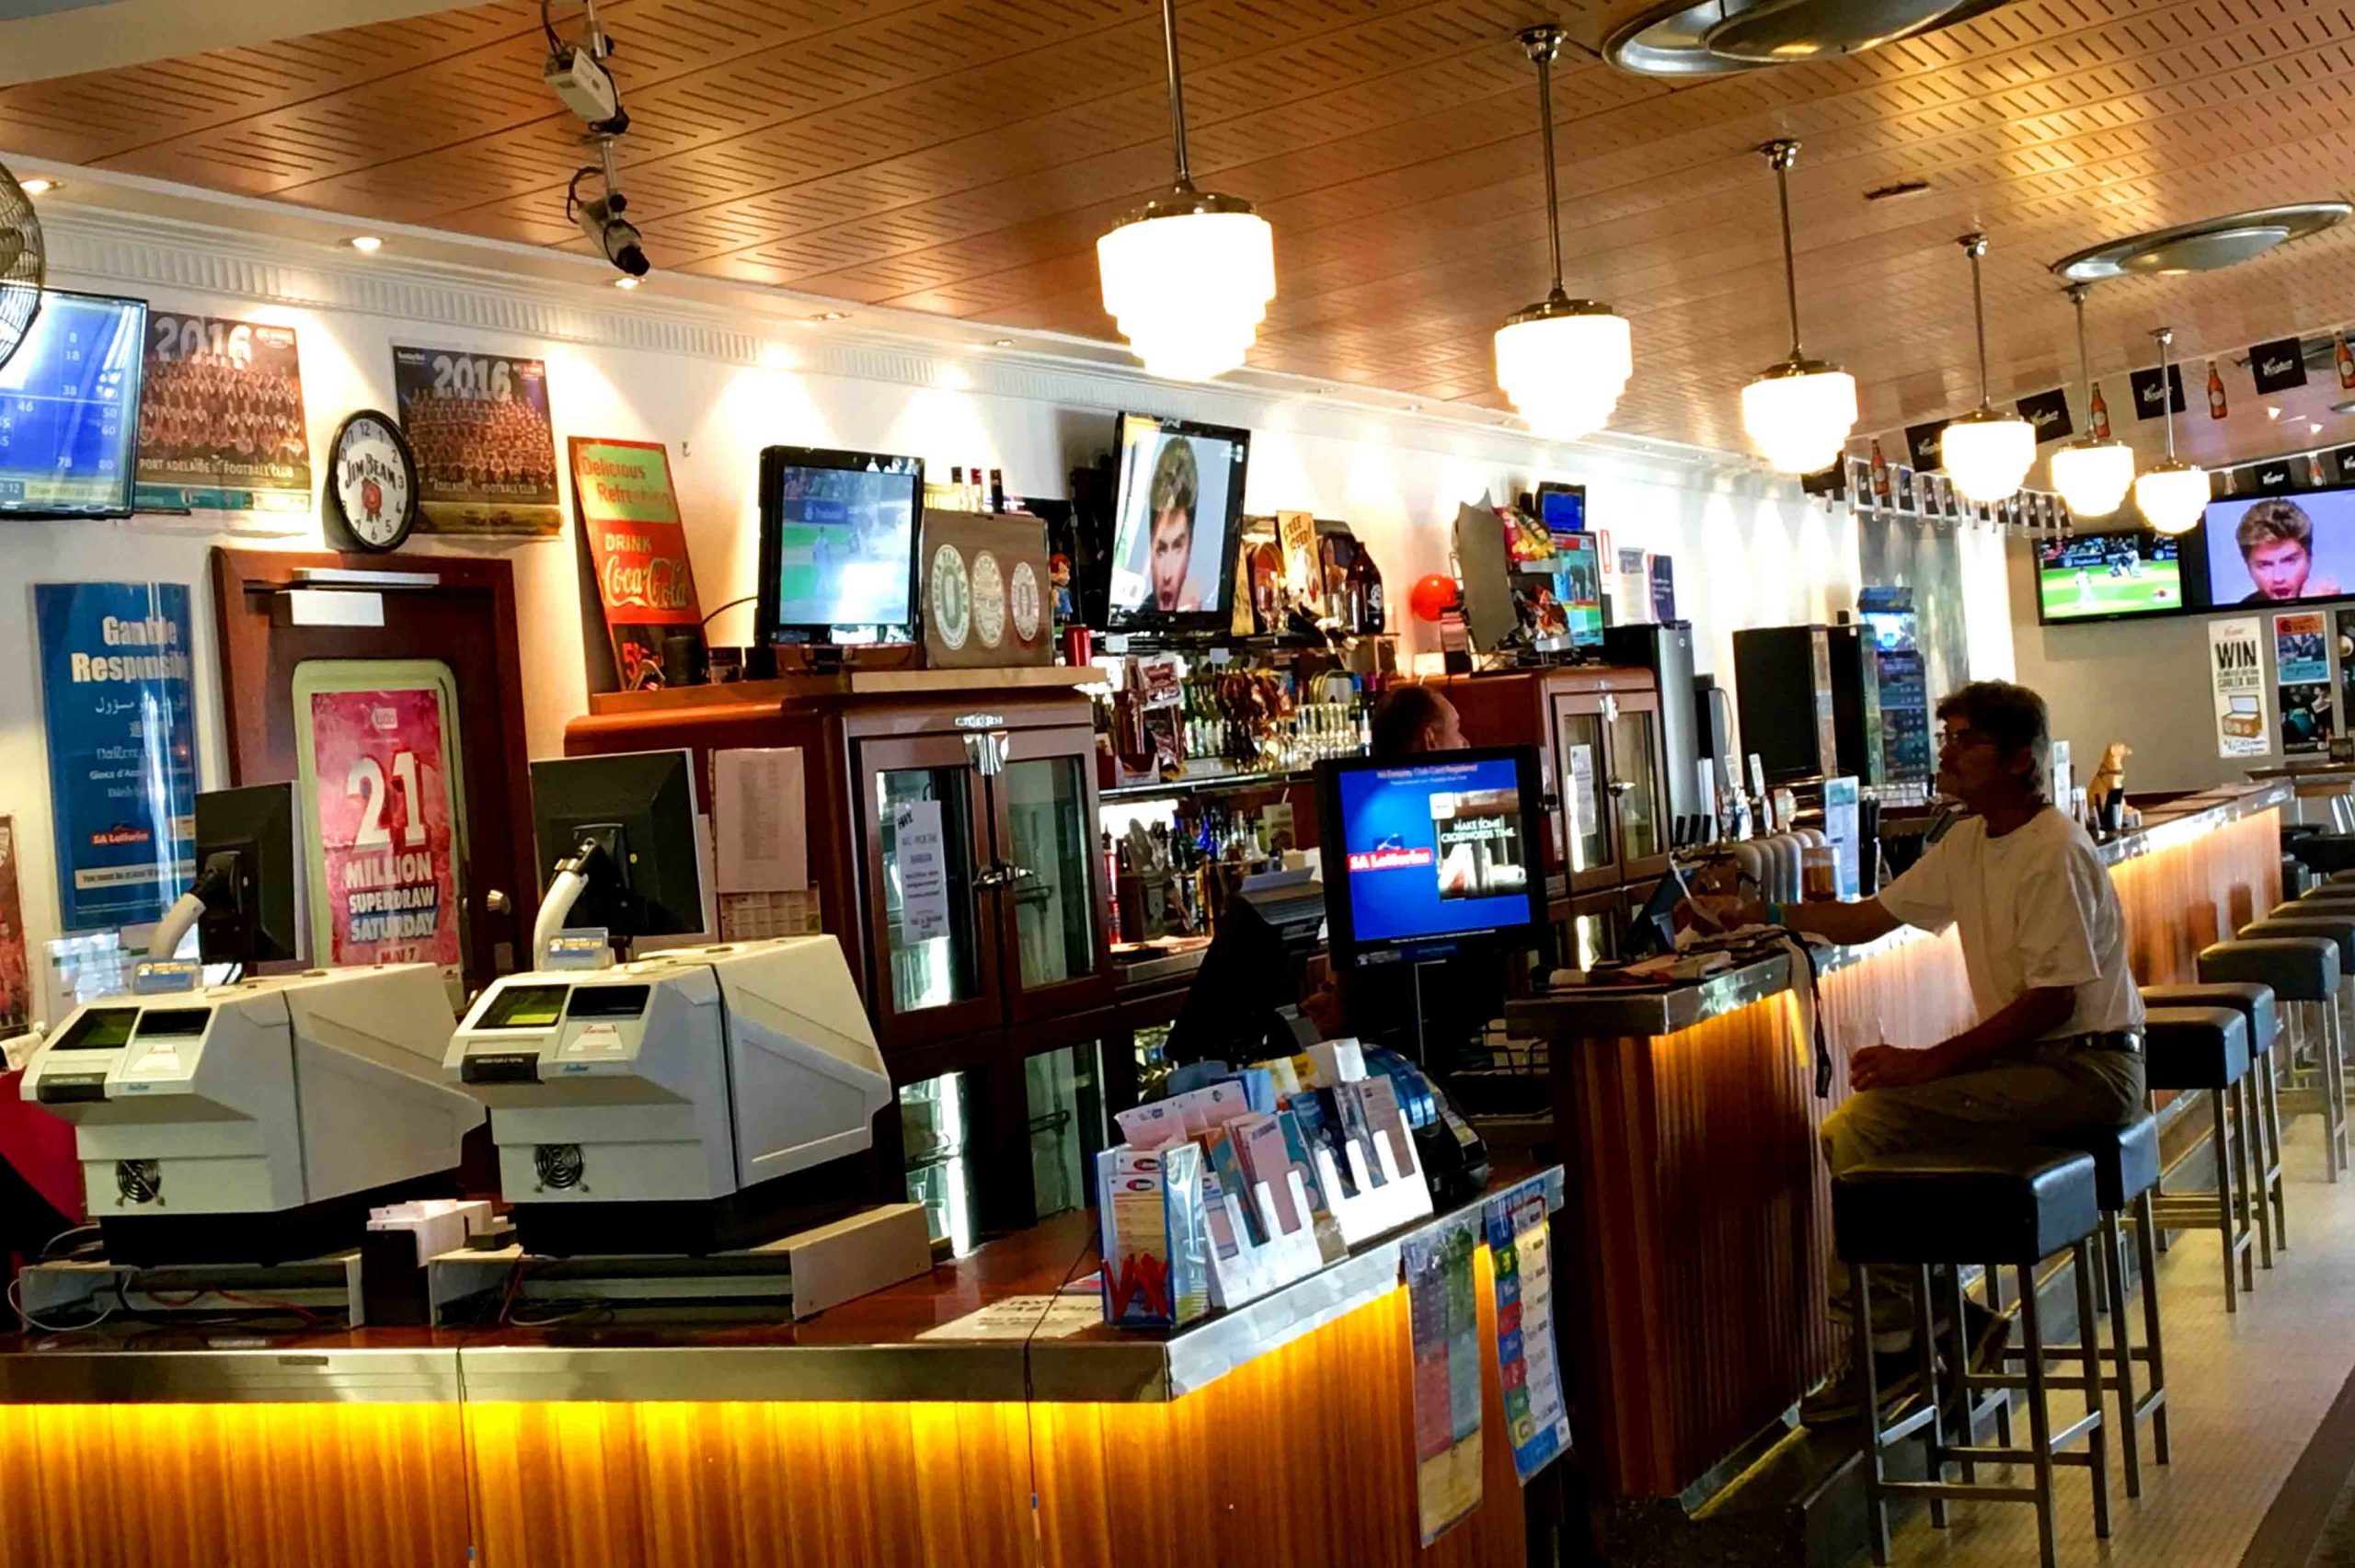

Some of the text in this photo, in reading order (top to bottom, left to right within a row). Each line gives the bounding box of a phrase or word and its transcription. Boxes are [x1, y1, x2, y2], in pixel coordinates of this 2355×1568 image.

[155, 316, 253, 370] 2016
[432, 355, 512, 402] 2016
[17, 400, 34, 413] 46
[101, 424, 116, 435] 60
[360, 422, 370, 437] 12
[140, 458, 295, 478] PORT ADELAIDE FOOTBALL CLUB
[344, 452, 397, 491] JIM BEAM
[581, 456, 646, 479] Delicious
[603, 532, 653, 553] DRINK
[603, 555, 688, 608] Coca-Cola
[102, 615, 178, 646] Gamble
[2215, 639, 2257, 670] WIN
[346, 751, 427, 850] 21
[1441, 829, 1493, 843] CROSSWORDS
[1453, 818, 1501, 831] MAKE SOME
[93, 834, 108, 845] SA
[345, 853, 432, 888] MILLION
[1350, 852, 1430, 870] SA Lotteries
[349, 888, 435, 914] SUPERDRAW
[350, 913, 435, 942] SATURDAY
